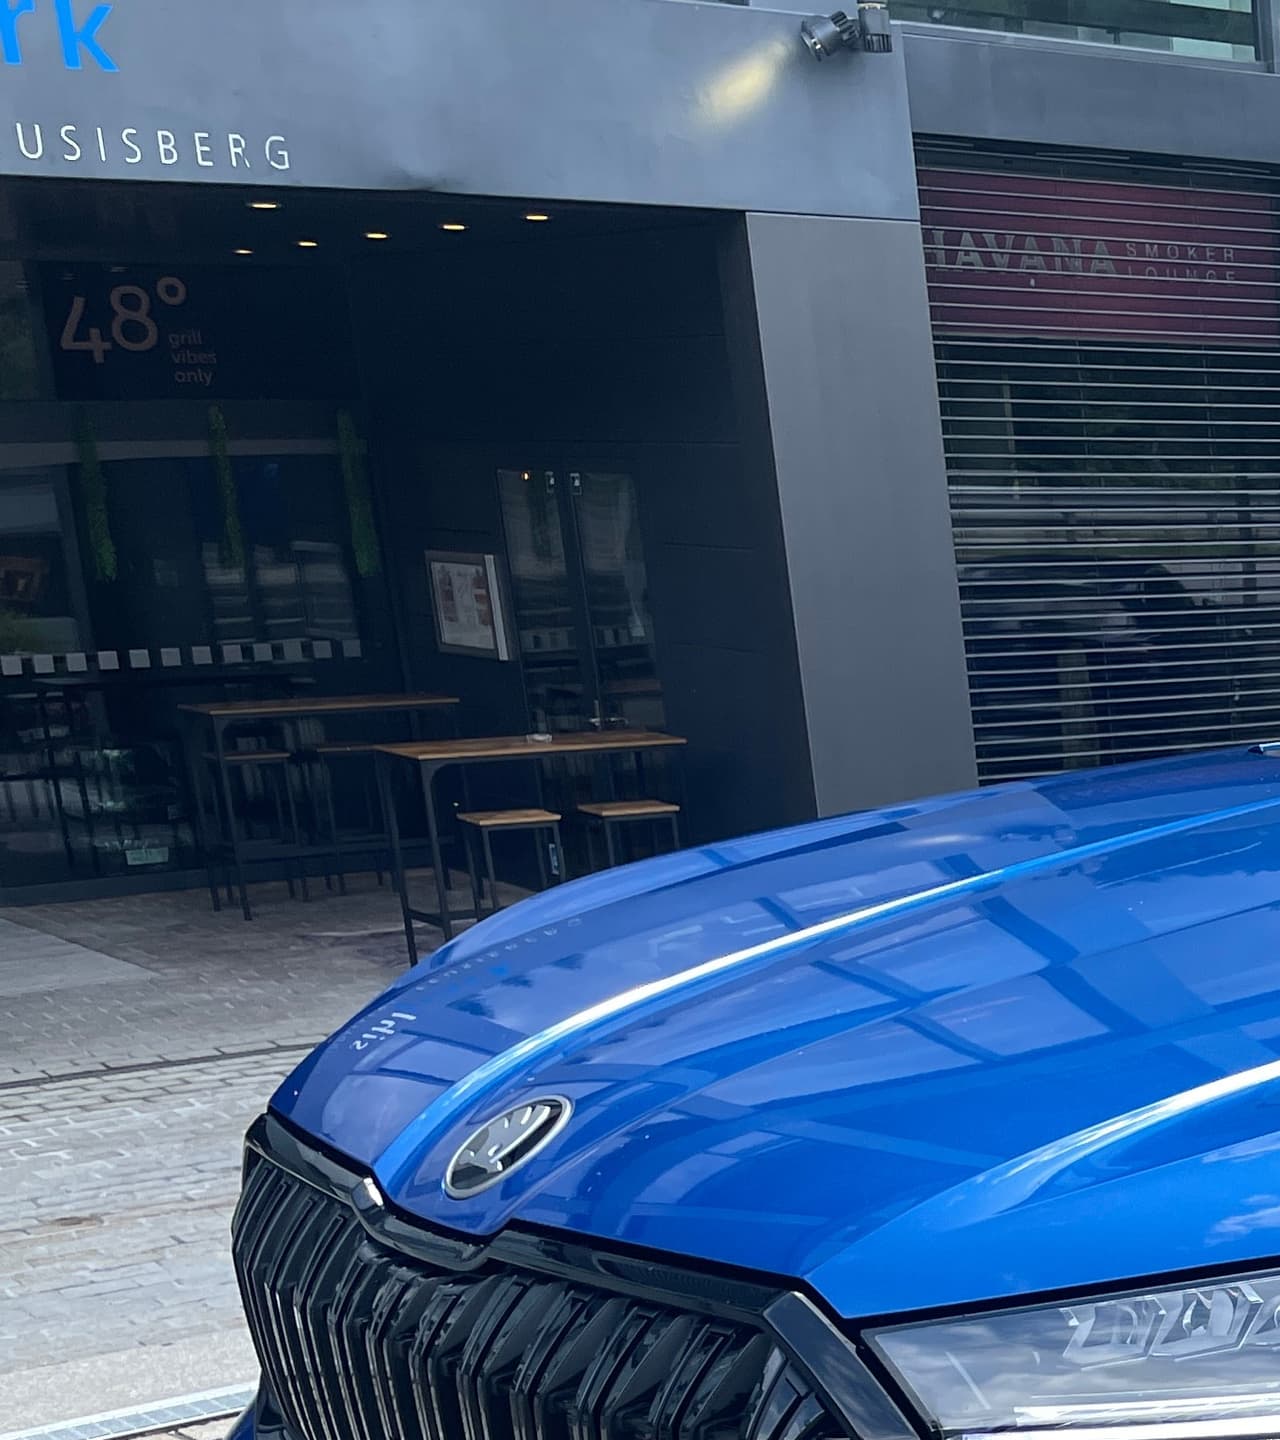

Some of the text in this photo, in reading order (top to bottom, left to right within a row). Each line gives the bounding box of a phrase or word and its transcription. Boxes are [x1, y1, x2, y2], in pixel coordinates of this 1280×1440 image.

[15, 122, 290, 170] USISBERG
[1126, 243, 1234, 262] SMOKER
[170, 350, 217, 364] vibes
[175, 368, 213, 386] only
